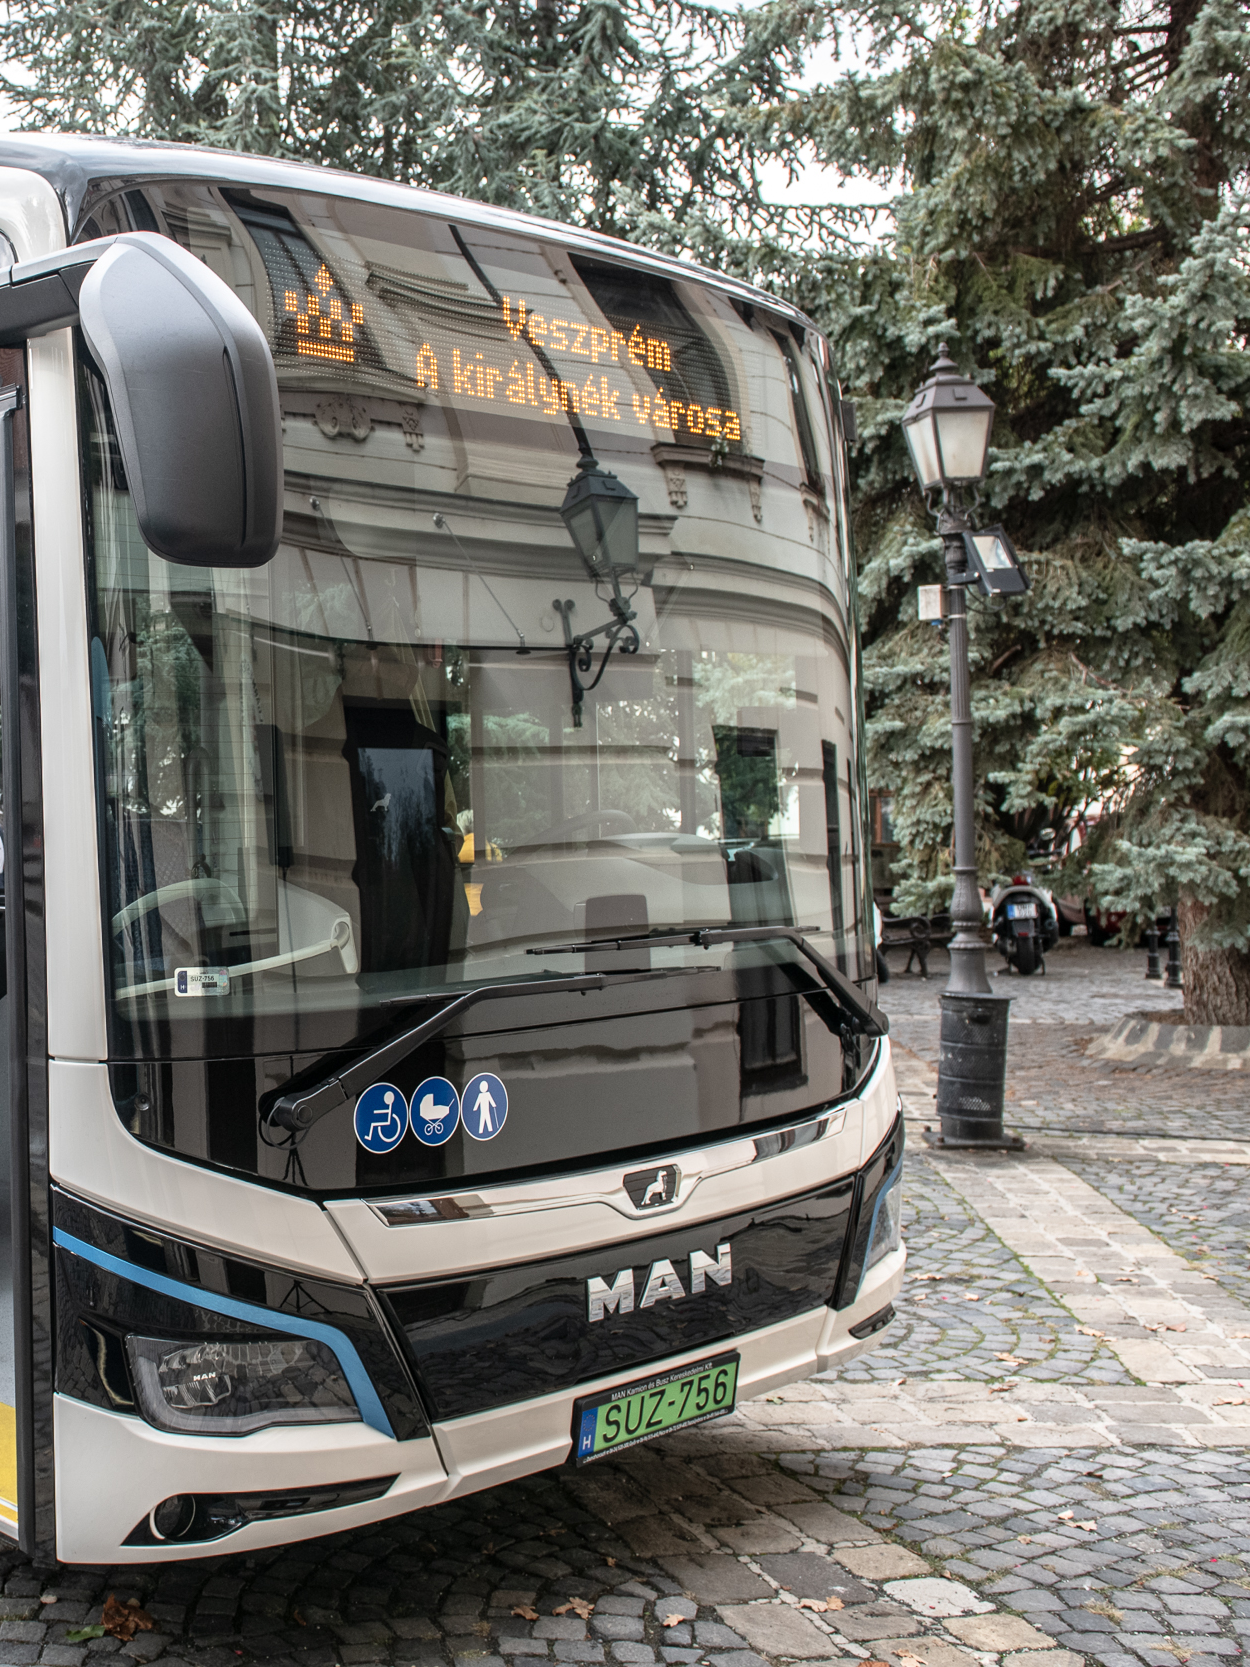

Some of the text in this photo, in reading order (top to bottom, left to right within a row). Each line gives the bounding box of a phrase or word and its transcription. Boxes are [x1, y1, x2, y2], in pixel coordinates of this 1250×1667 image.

[502, 296, 671, 371] Veszprém
[416, 343, 740, 440] A királynék városa
[586, 1242, 733, 1323] MAN
[193, 1371, 216, 1382] MAN
[582, 1434, 592, 1451] H
[602, 1368, 729, 1444] SUZ-756
[611, 1391, 627, 1401] MAN
[655, 1377, 669, 1388] Busz
